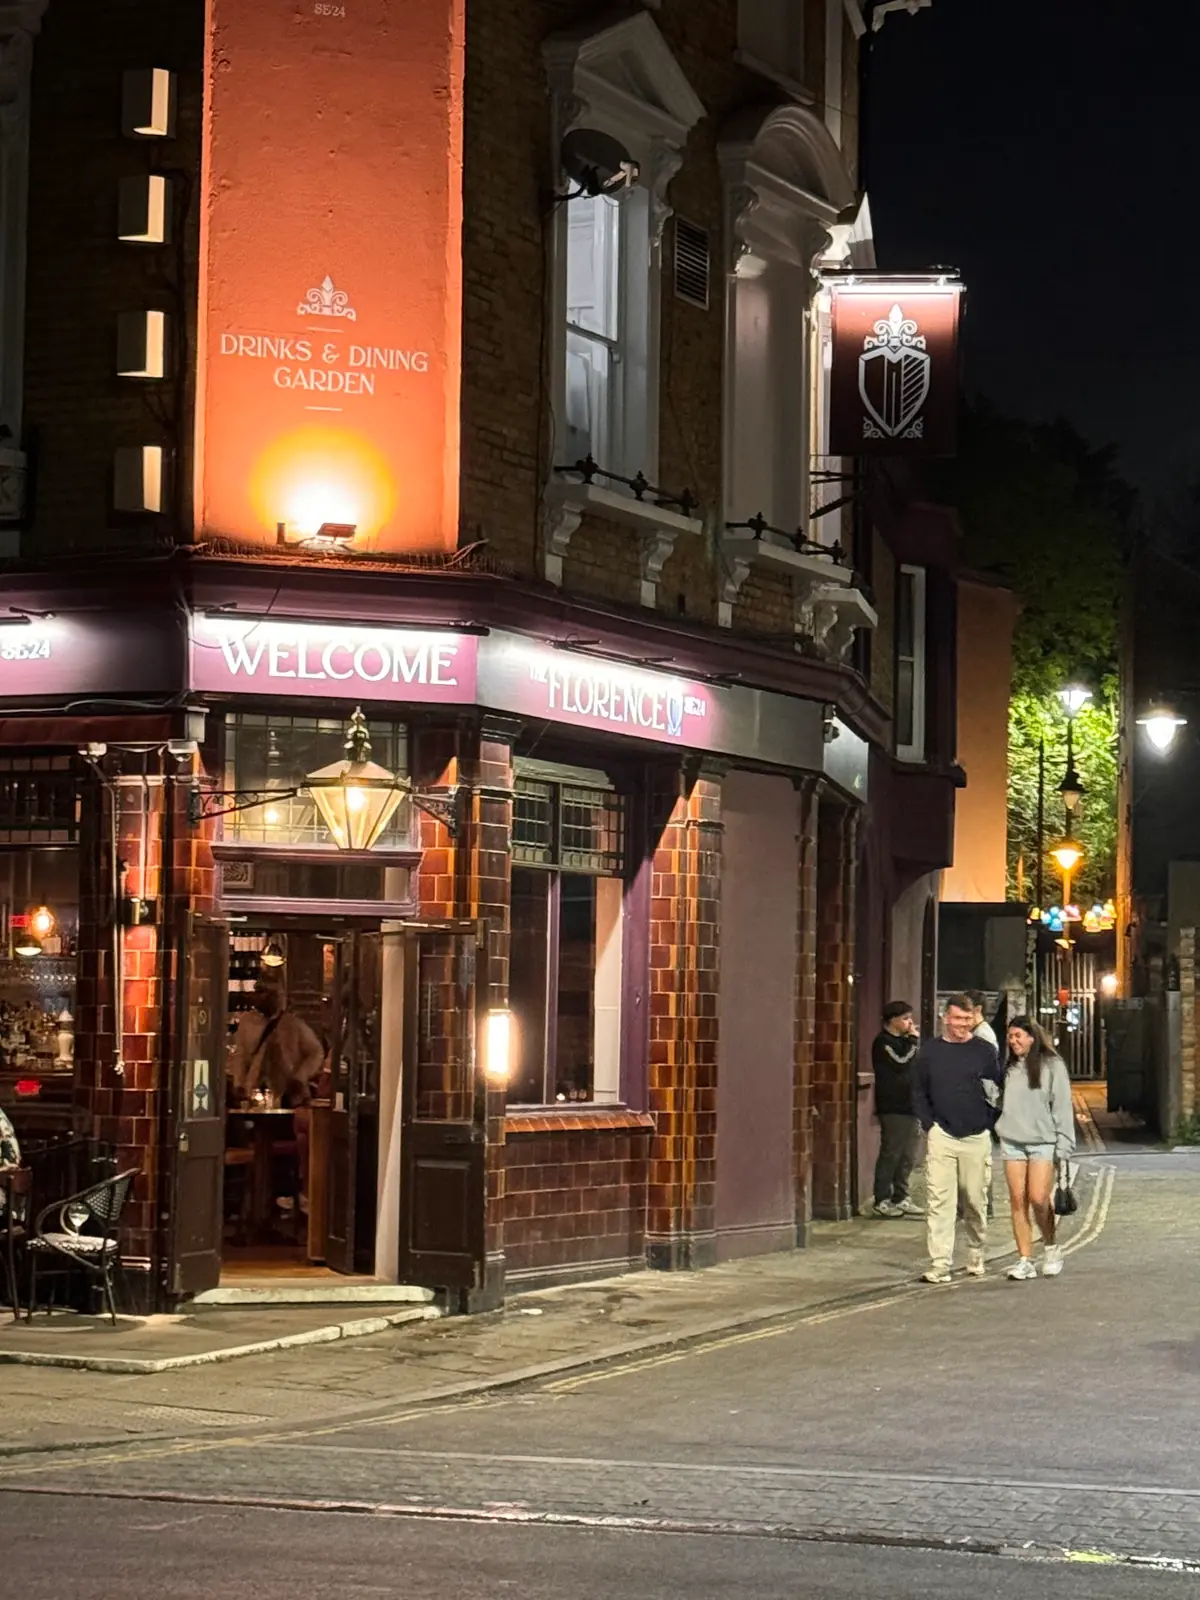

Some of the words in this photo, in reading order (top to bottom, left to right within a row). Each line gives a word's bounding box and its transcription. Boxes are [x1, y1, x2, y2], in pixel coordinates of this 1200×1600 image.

[314, 2, 346, 18] SE24
[220, 333, 313, 362] DRINKS
[322, 343, 340, 364] &
[349, 345, 429, 372] DINING
[273, 366, 375, 396] GARDEN
[217, 636, 458, 686] WELCOME
[547, 667, 666, 730] FLORENCE
